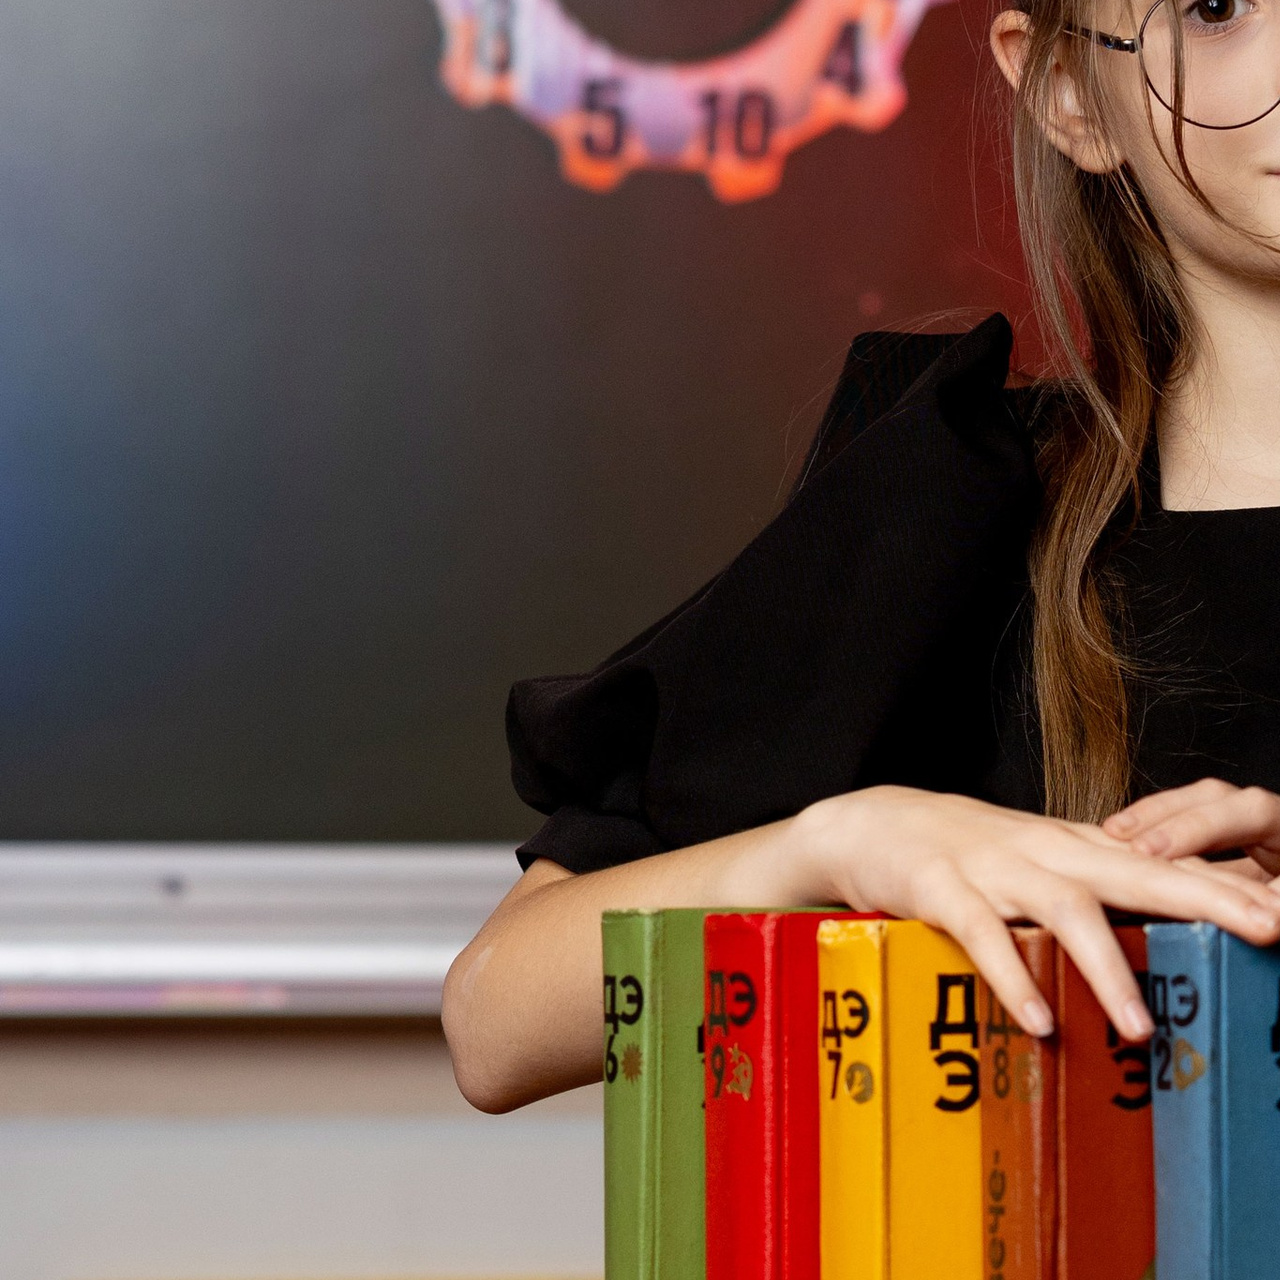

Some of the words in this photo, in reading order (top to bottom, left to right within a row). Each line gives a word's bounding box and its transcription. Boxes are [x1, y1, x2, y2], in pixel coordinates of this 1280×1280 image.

[825, 21, 863, 95] 4
[582, 81, 627, 158] 5
[700, 89, 772, 158] 10
[708, 971, 757, 1036] ДЭ
[822, 991, 870, 1047] ДЭ
[1151, 974, 1198, 1037] ДЭ
[605, 1033, 618, 1084] 6
[711, 1044, 726, 1099] 9
[827, 1052, 842, 1100] 7
[994, 1048, 1010, 1098] 8
[1155, 1038, 1171, 1090] 2
